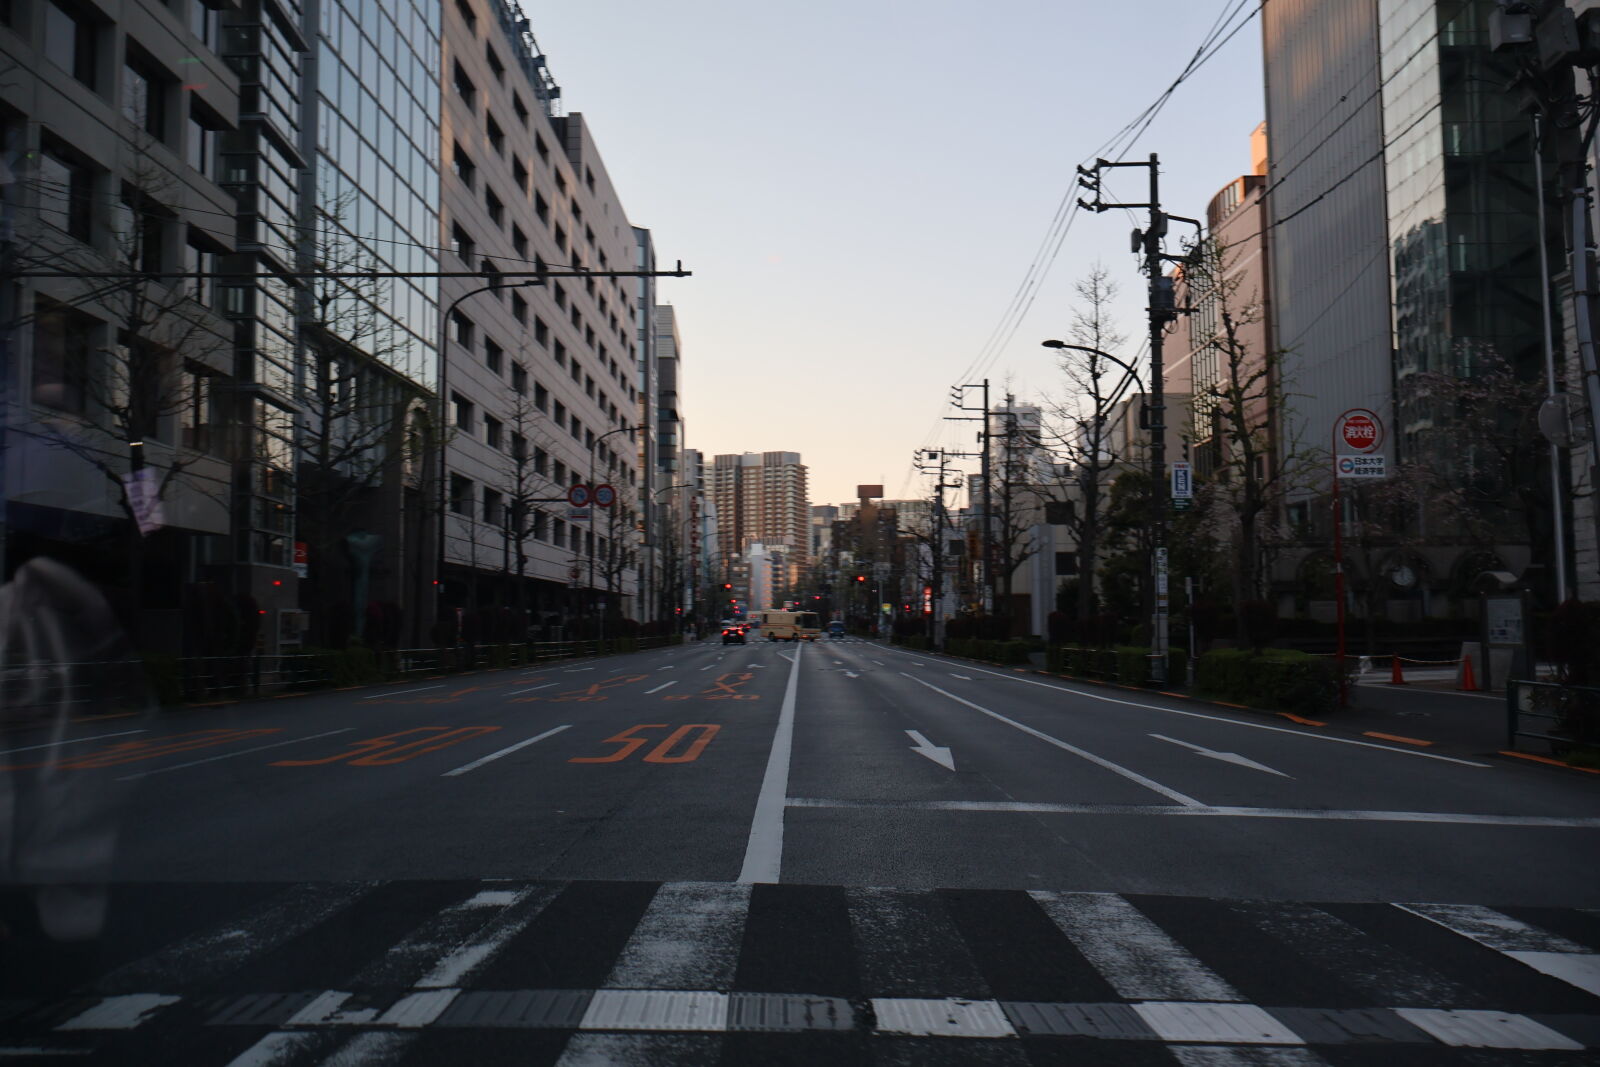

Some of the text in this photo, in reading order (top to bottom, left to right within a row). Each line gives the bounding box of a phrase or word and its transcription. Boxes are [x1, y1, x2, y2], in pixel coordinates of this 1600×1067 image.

[1344, 425, 1376, 439] 消火栓
[1354, 457, 1384, 466] 日本大学
[268, 725, 502, 767] 50
[569, 723, 721, 764] 50
